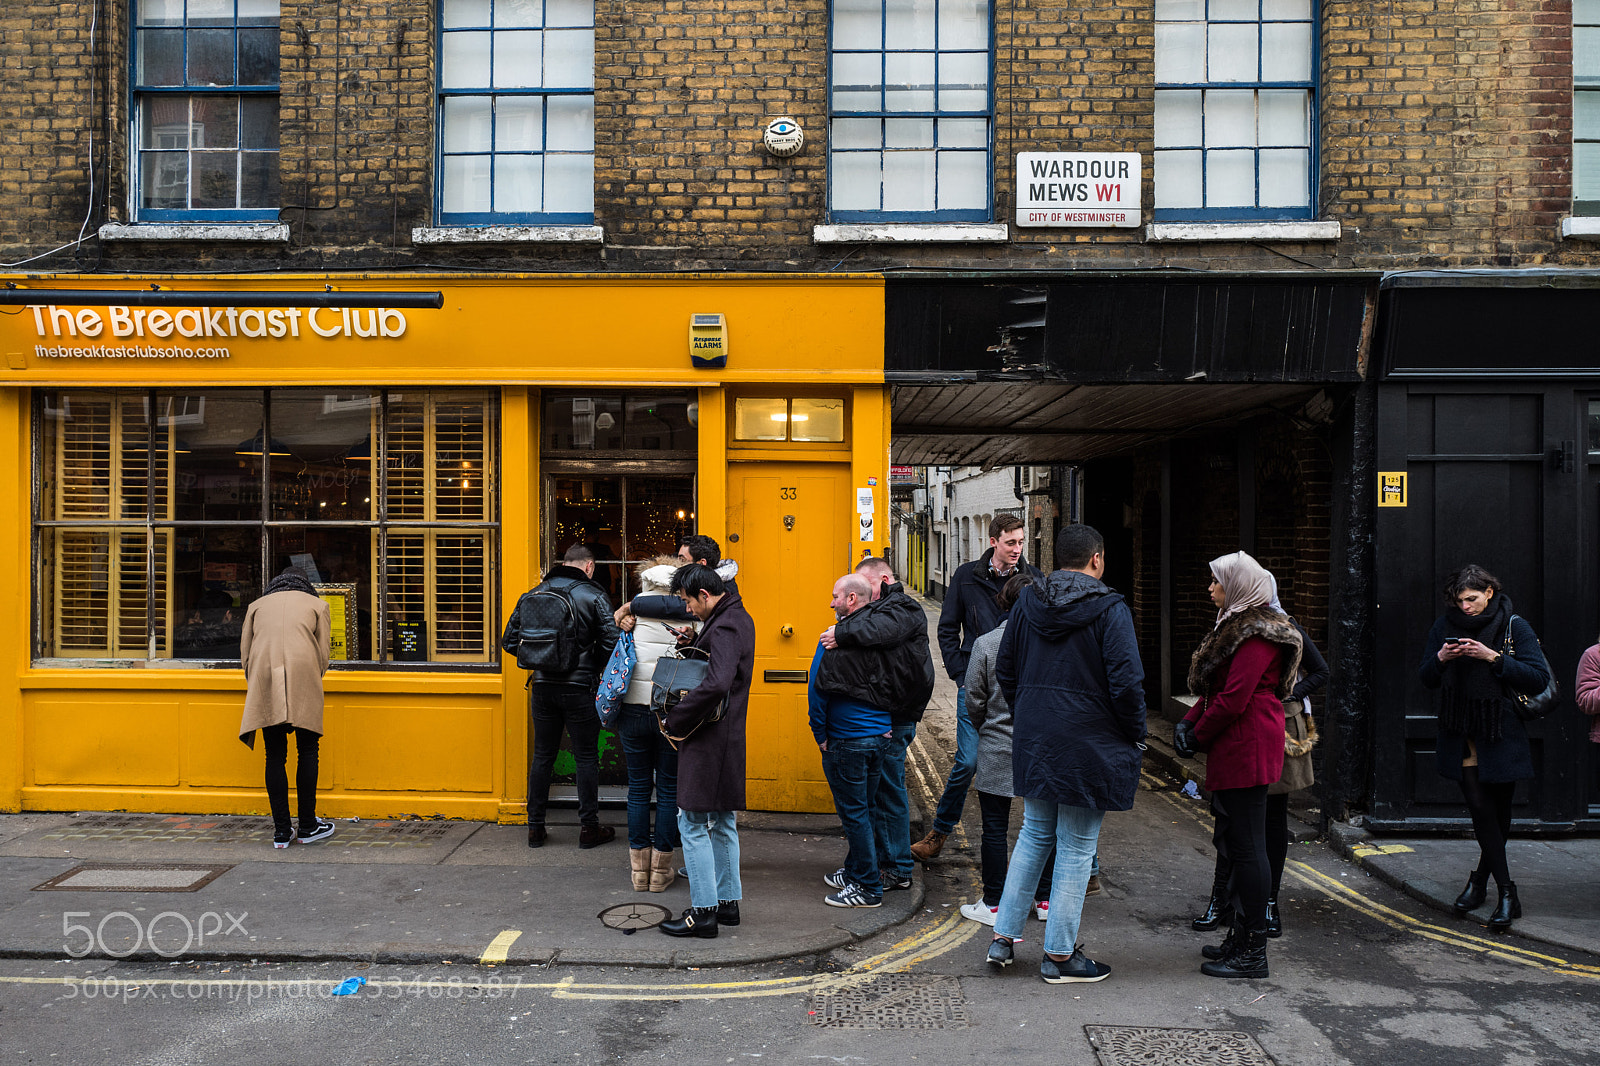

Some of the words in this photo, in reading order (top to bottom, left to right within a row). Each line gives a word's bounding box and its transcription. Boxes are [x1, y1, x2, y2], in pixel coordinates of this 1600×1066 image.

[1030, 160, 1129, 179] WARDOUR
[1029, 183, 1089, 202] MEWS
[1095, 183, 1121, 202] W1
[1029, 212, 1048, 222] CITY
[1051, 212, 1062, 222] OF
[1064, 213, 1126, 222] WESTMINSTER
[26, 304, 104, 337] The
[108, 305, 302, 338] Breakfast
[308, 307, 407, 338] Club
[34, 344, 230, 359] thebreakfastclubsoho.com
[780, 487, 797, 501] 33
